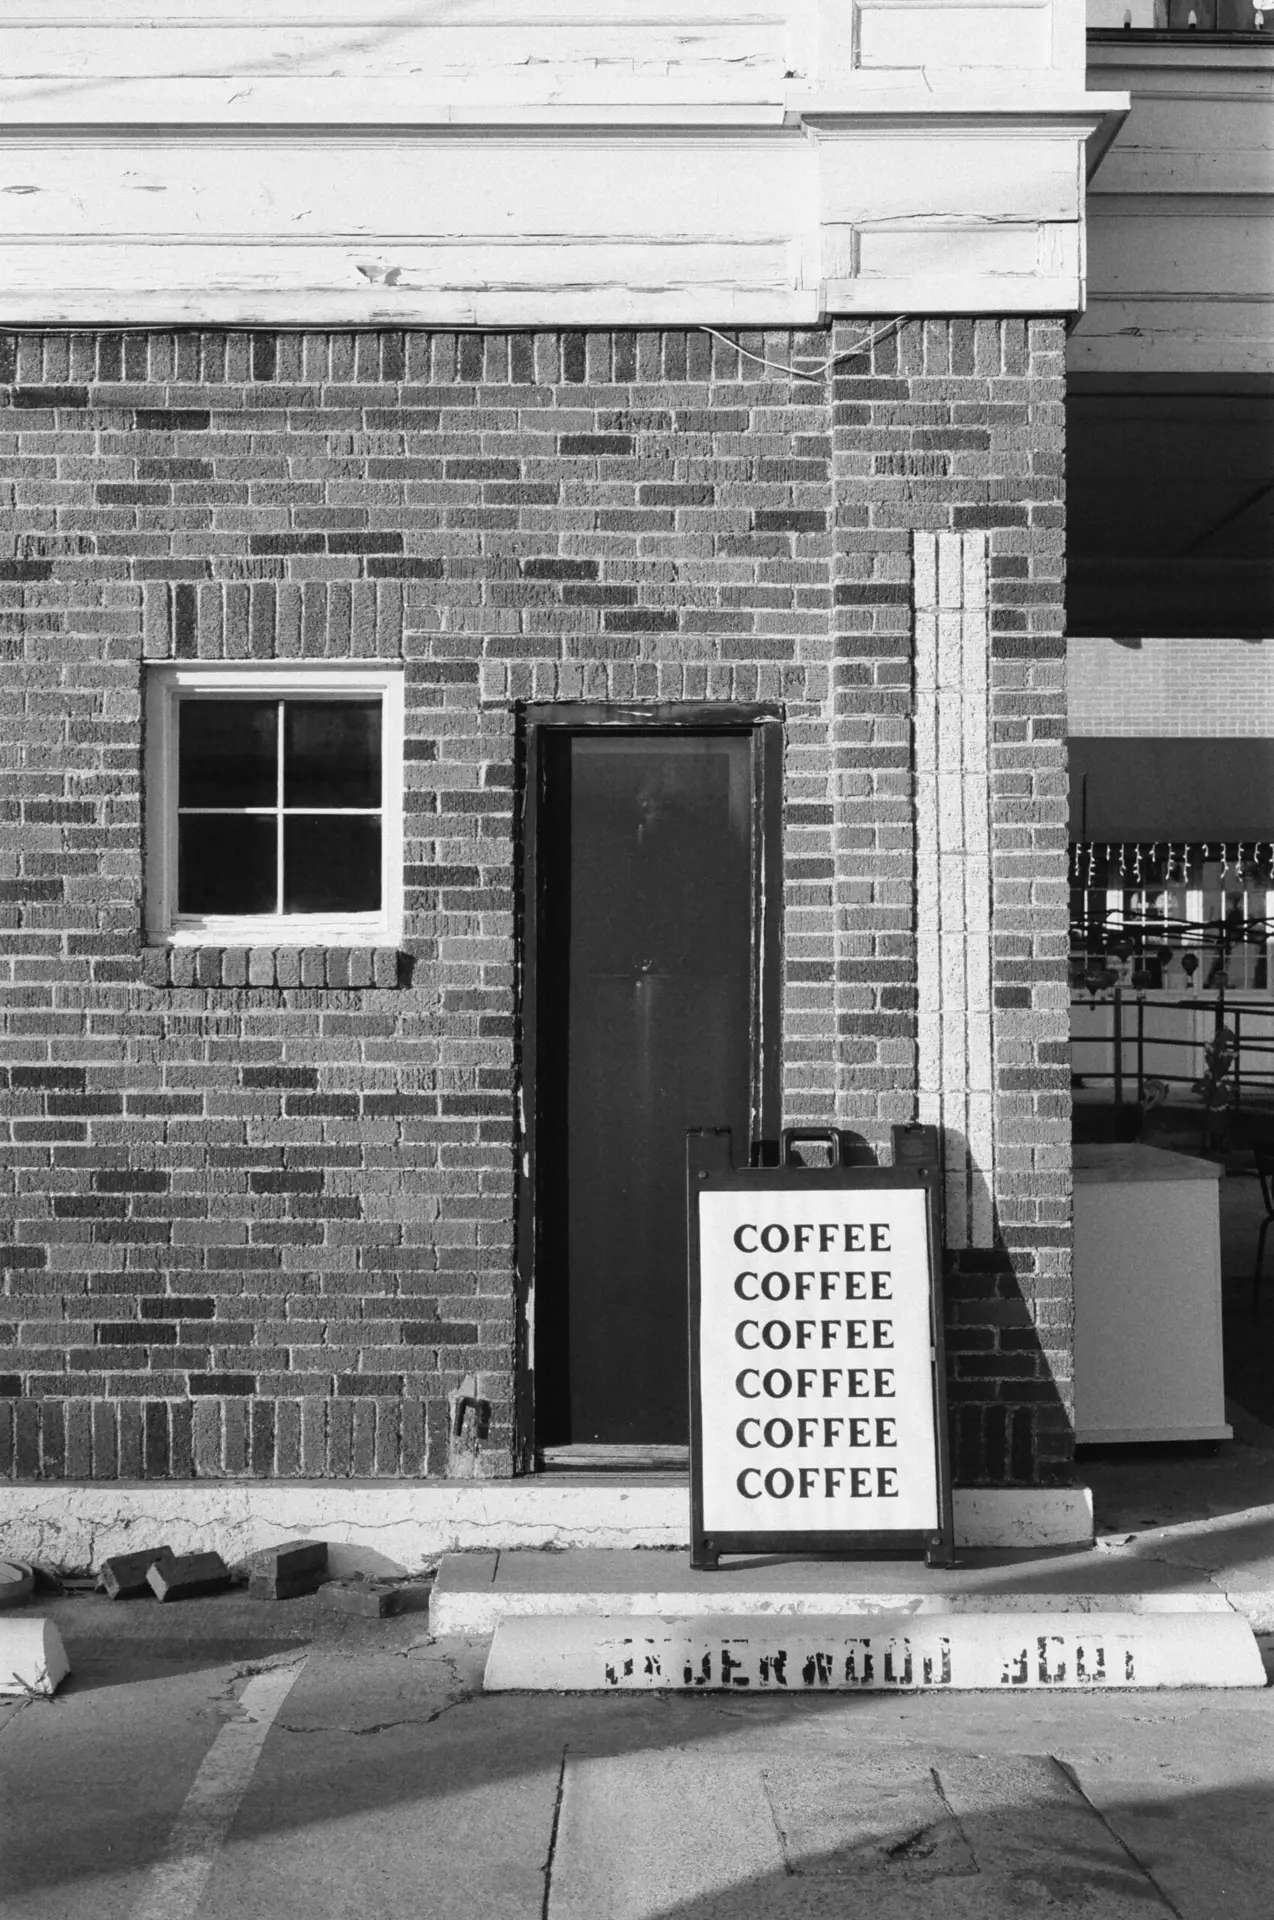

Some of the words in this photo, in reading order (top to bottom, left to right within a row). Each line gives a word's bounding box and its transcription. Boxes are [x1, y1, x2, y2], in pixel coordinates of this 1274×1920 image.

[733, 1223, 892, 1253] COFFEE
[734, 1271, 893, 1301] COFFEE
[735, 1319, 895, 1350] COFFEE
[735, 1368, 896, 1399] COFFEE
[736, 1417, 898, 1449] COFFEE
[737, 1467, 899, 1499] COFFEE
